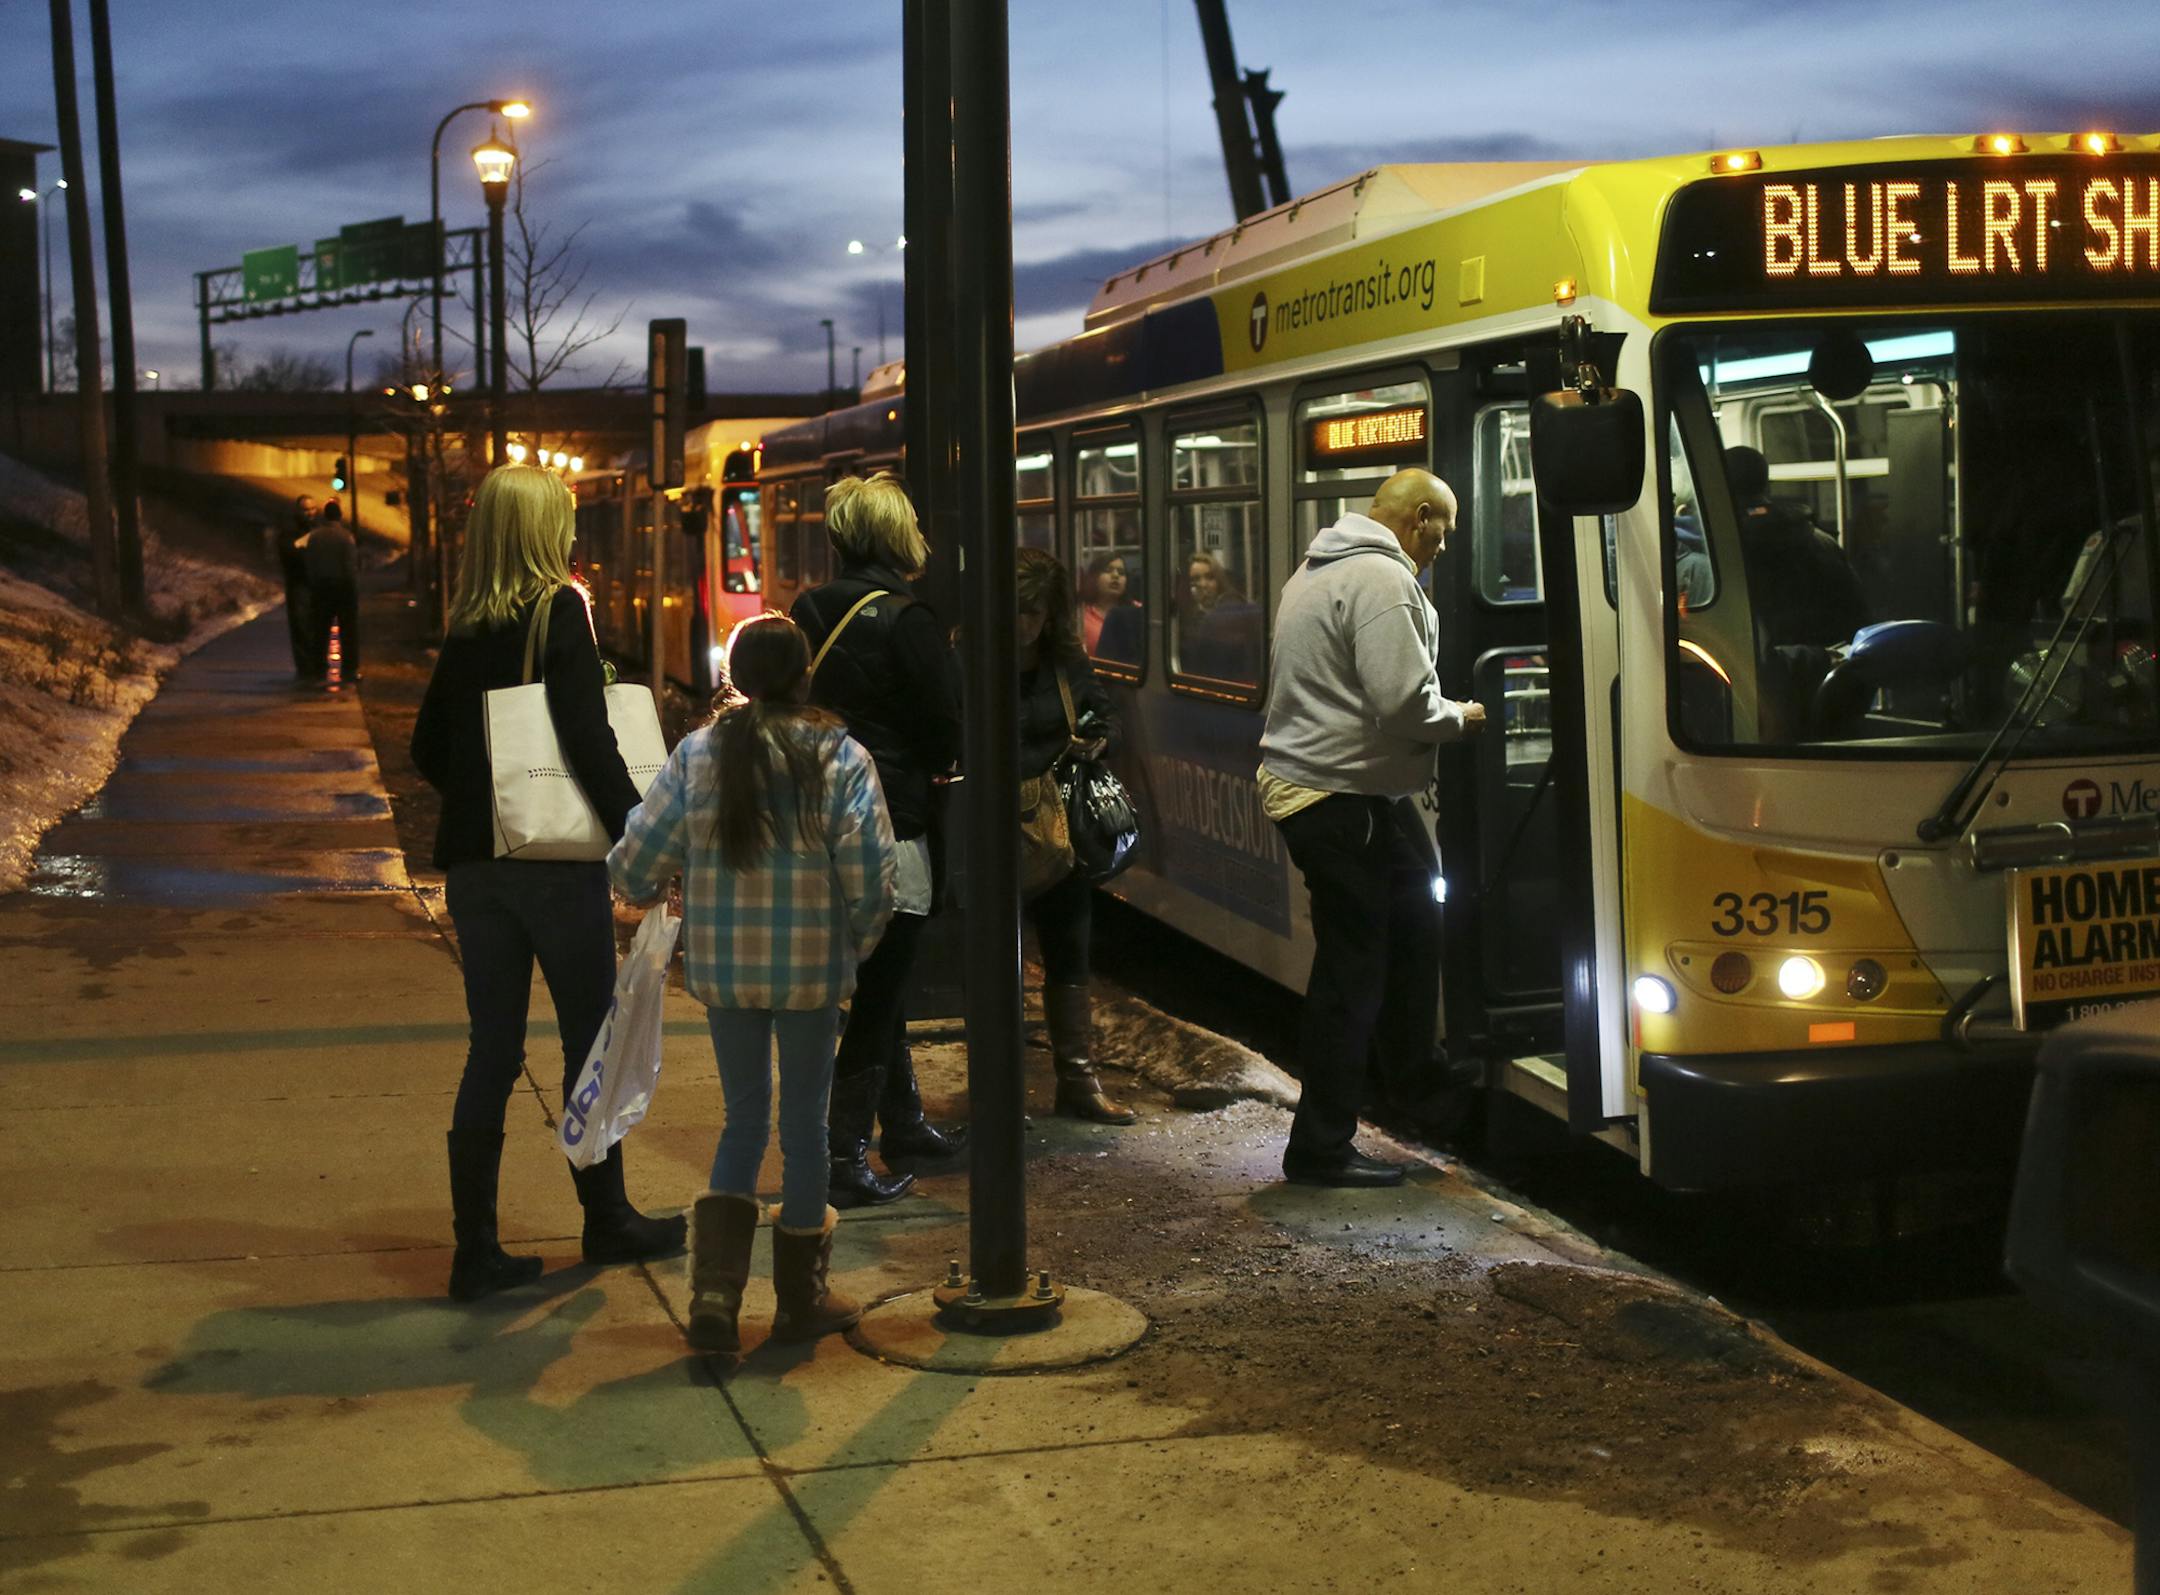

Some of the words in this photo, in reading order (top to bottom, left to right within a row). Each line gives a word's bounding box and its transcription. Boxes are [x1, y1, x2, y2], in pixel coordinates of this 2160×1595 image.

[1763, 182, 1921, 276] BLUE
[1946, 179, 2057, 274] LRT
[2084, 176, 2159, 272] SH
[1275, 259, 1436, 334] metrotransit.org
[2110, 780, 2160, 813] Me
[1712, 890, 1831, 936] 3315
[2031, 867, 2160, 925] HOME
[2033, 973, 2056, 992] NO
[2060, 966, 2125, 990] CHARGE
